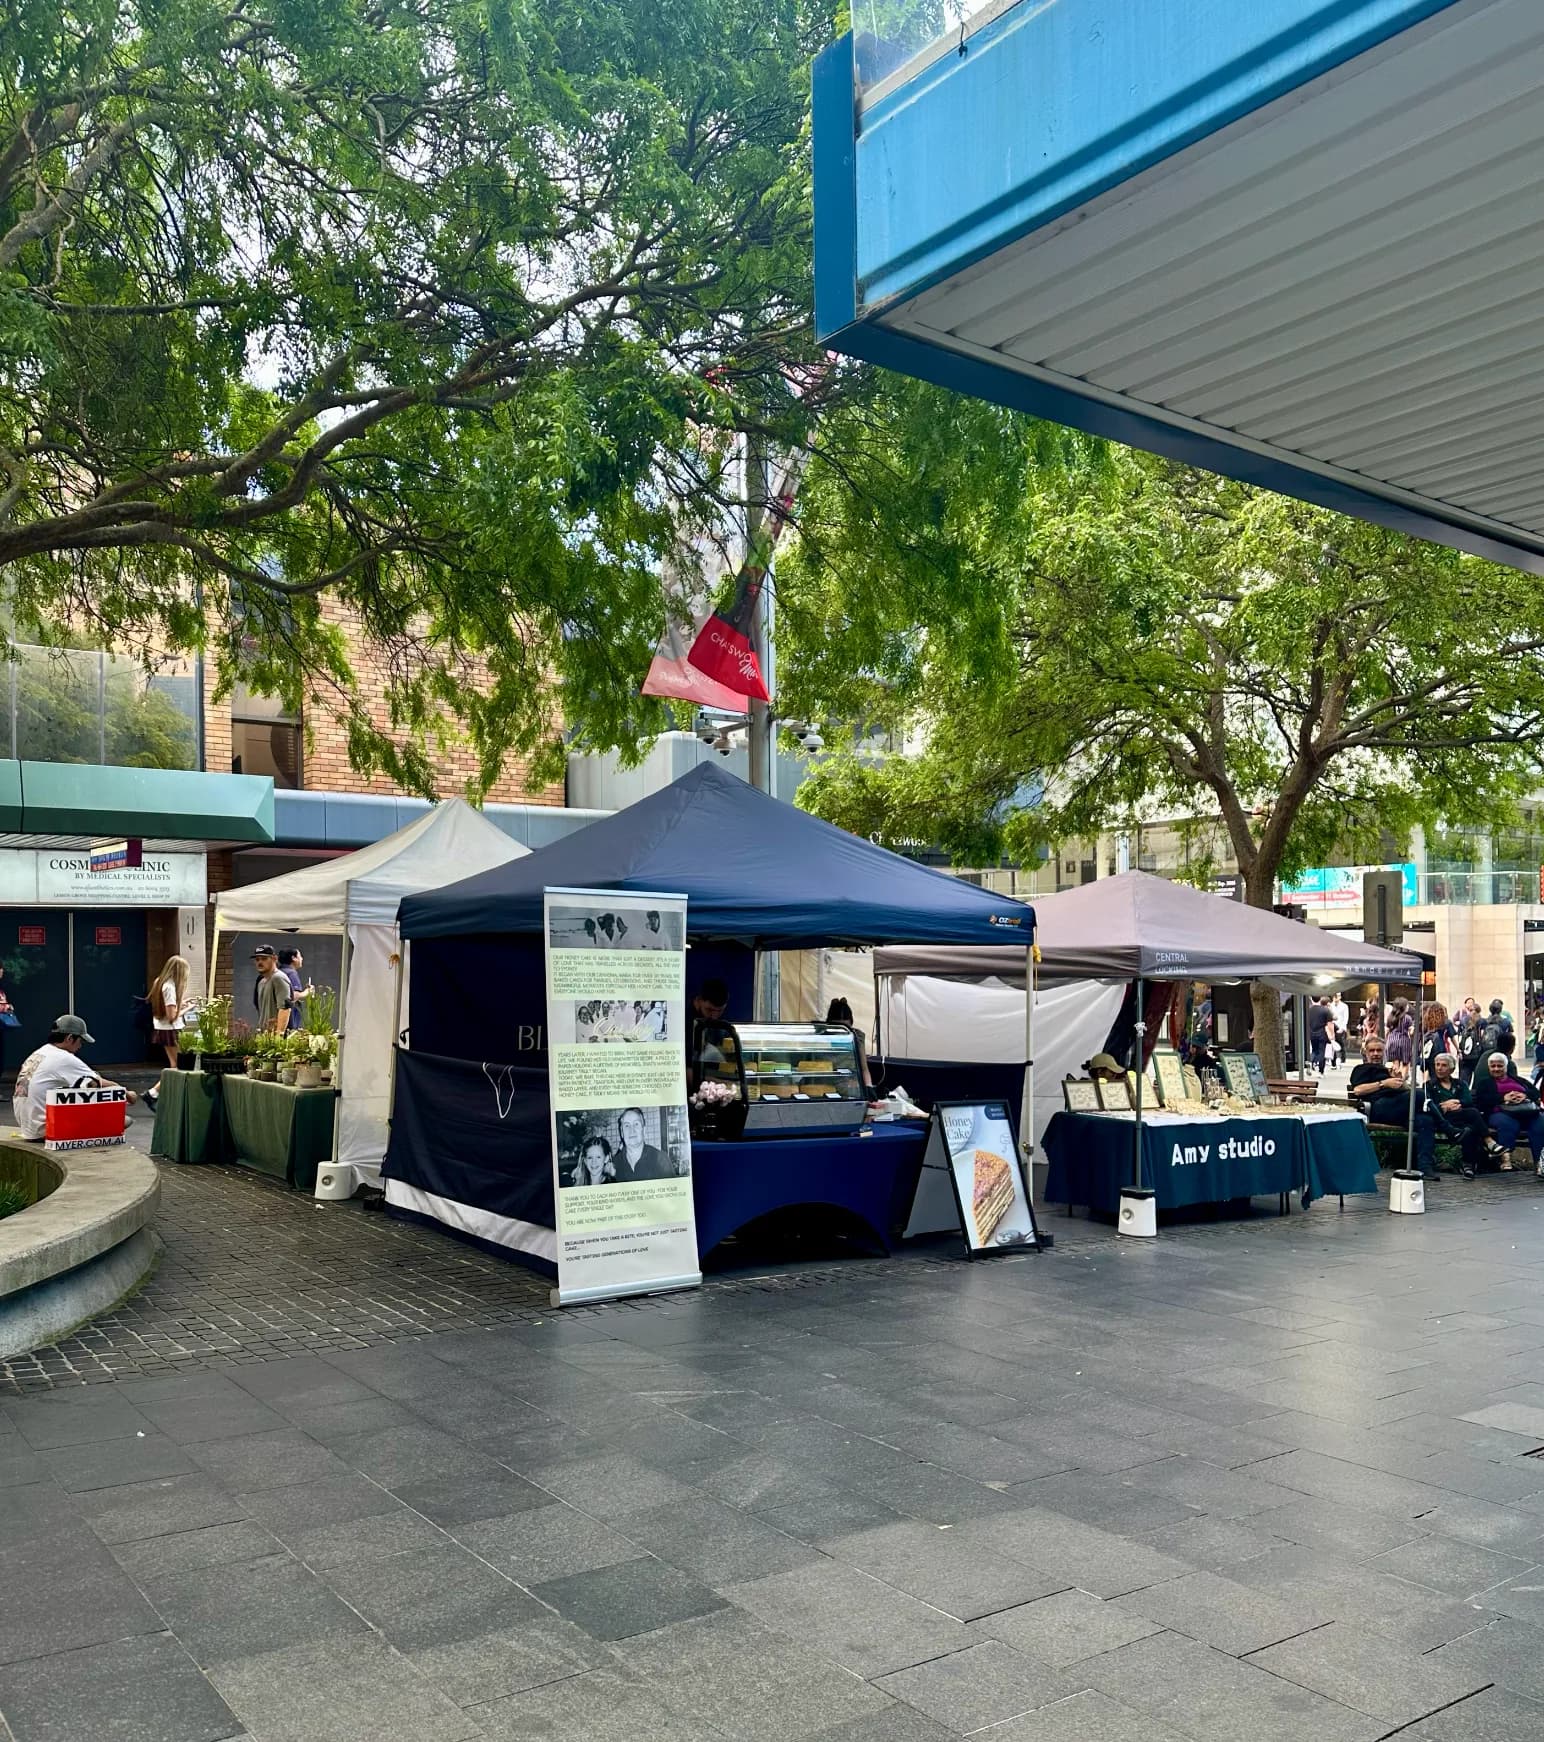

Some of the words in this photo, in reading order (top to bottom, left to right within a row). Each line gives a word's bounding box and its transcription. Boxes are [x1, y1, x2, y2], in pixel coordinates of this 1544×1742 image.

[87, 872, 121, 880] MEDICAL
[123, 873, 171, 881] SPECIALISTS
[1155, 952, 1189, 963] CENTRAL
[56, 1090, 126, 1105] MYER
[943, 1116, 972, 1128] Honey
[946, 1126, 970, 1139] Cake
[1171, 1143, 1210, 1166] Amy
[1218, 1135, 1276, 1160] studio
